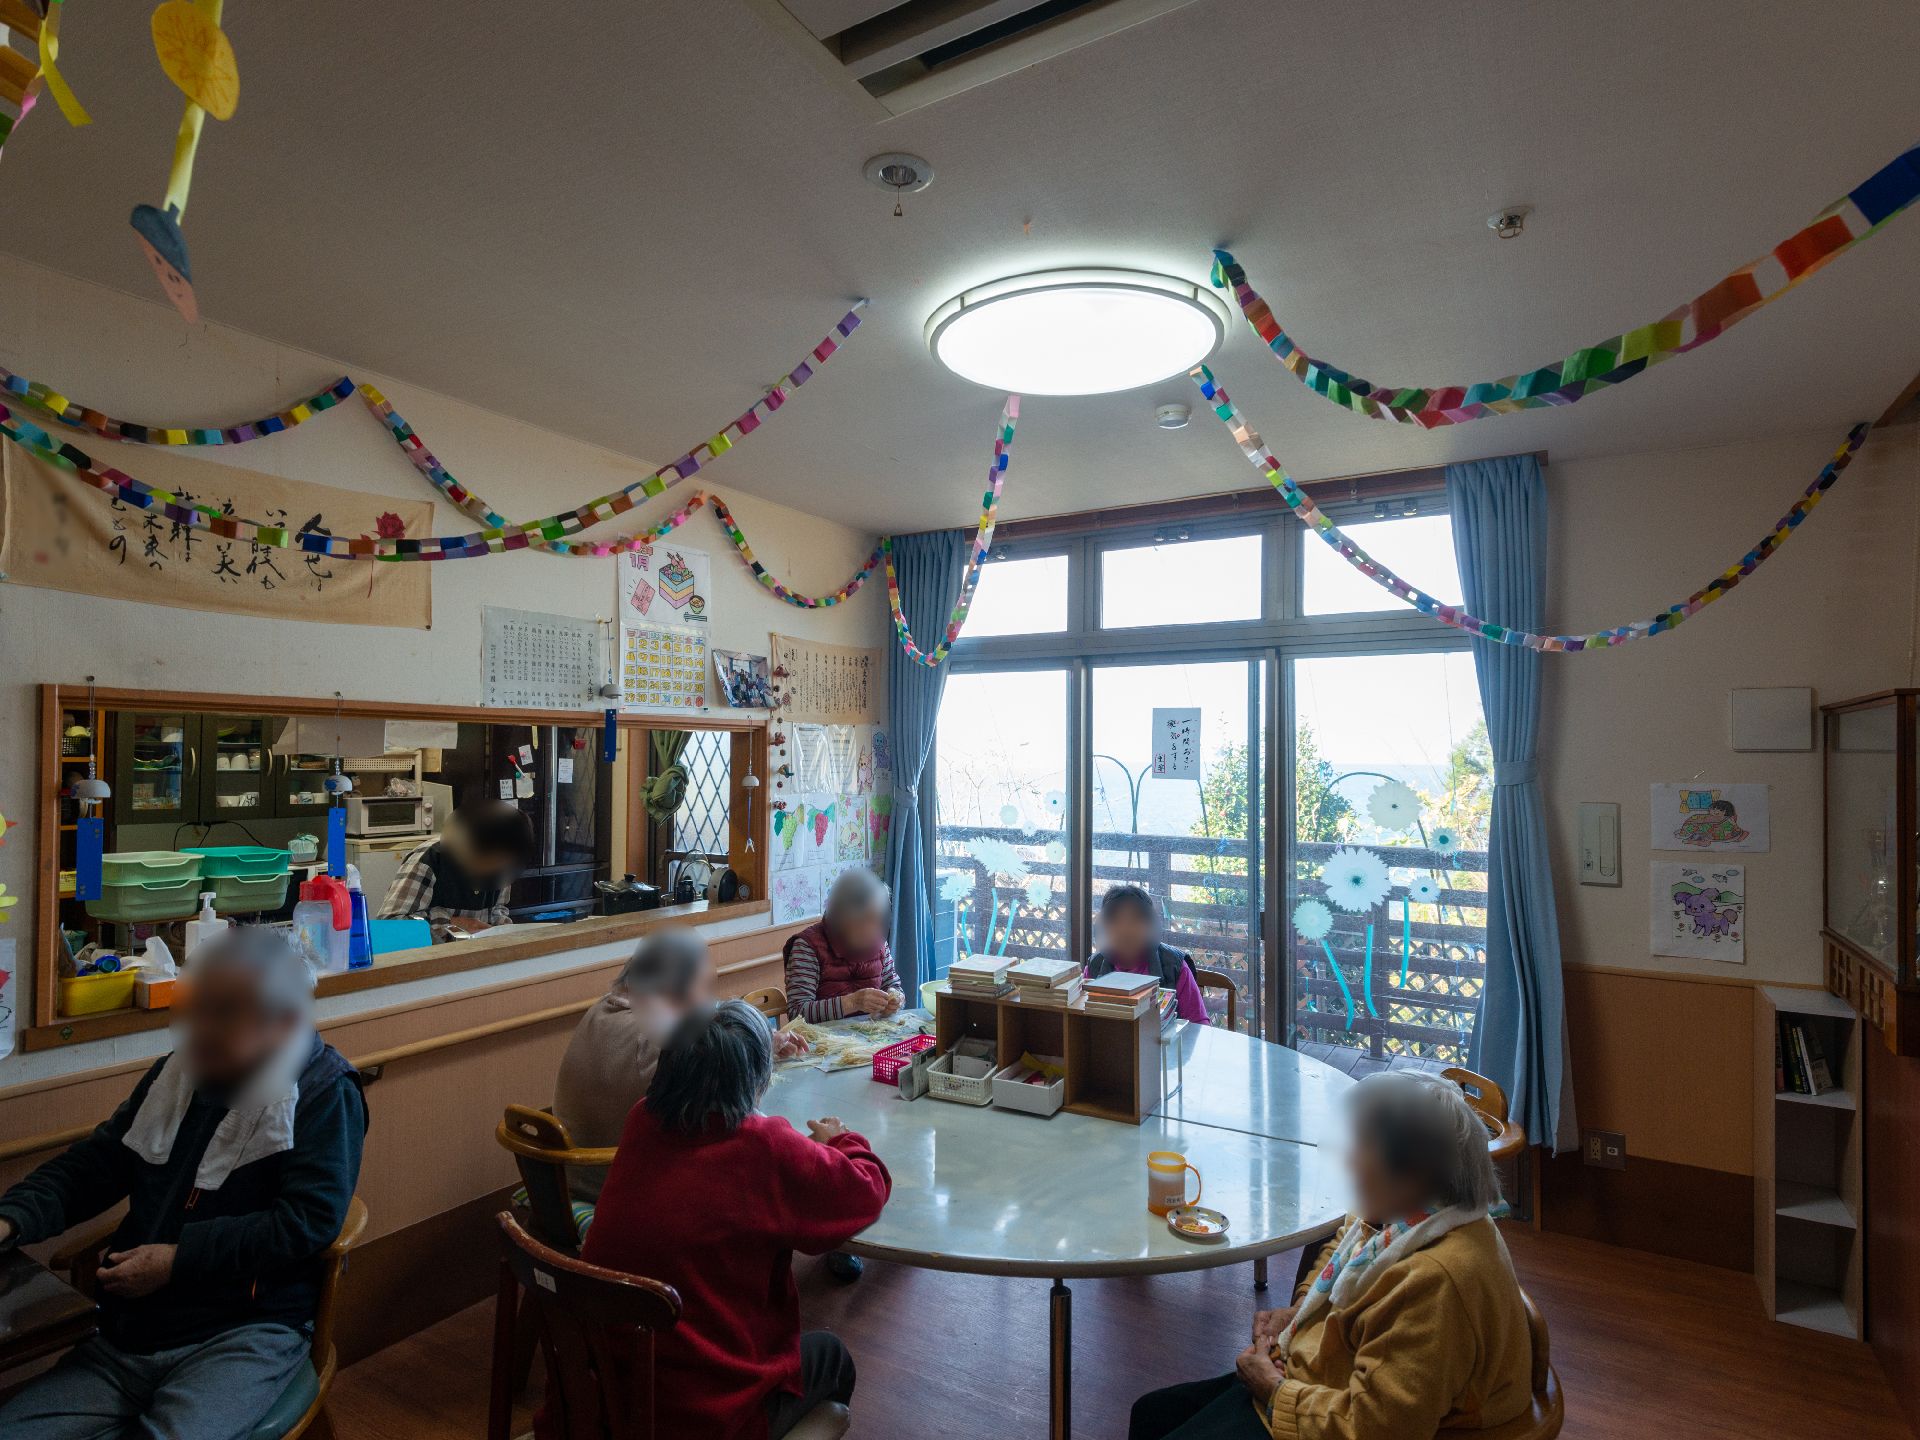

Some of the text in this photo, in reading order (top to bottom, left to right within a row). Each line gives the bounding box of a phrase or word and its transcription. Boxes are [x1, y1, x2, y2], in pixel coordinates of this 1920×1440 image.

[628, 638, 634, 649] 1
[639, 638, 647, 649] 2
[651, 639, 659, 650] 3
[663, 642, 671, 651] 4
[674, 643, 681, 652] 5
[638, 652, 648, 661] 9
[662, 655, 671, 665] 11
[650, 693, 659, 703] 31
